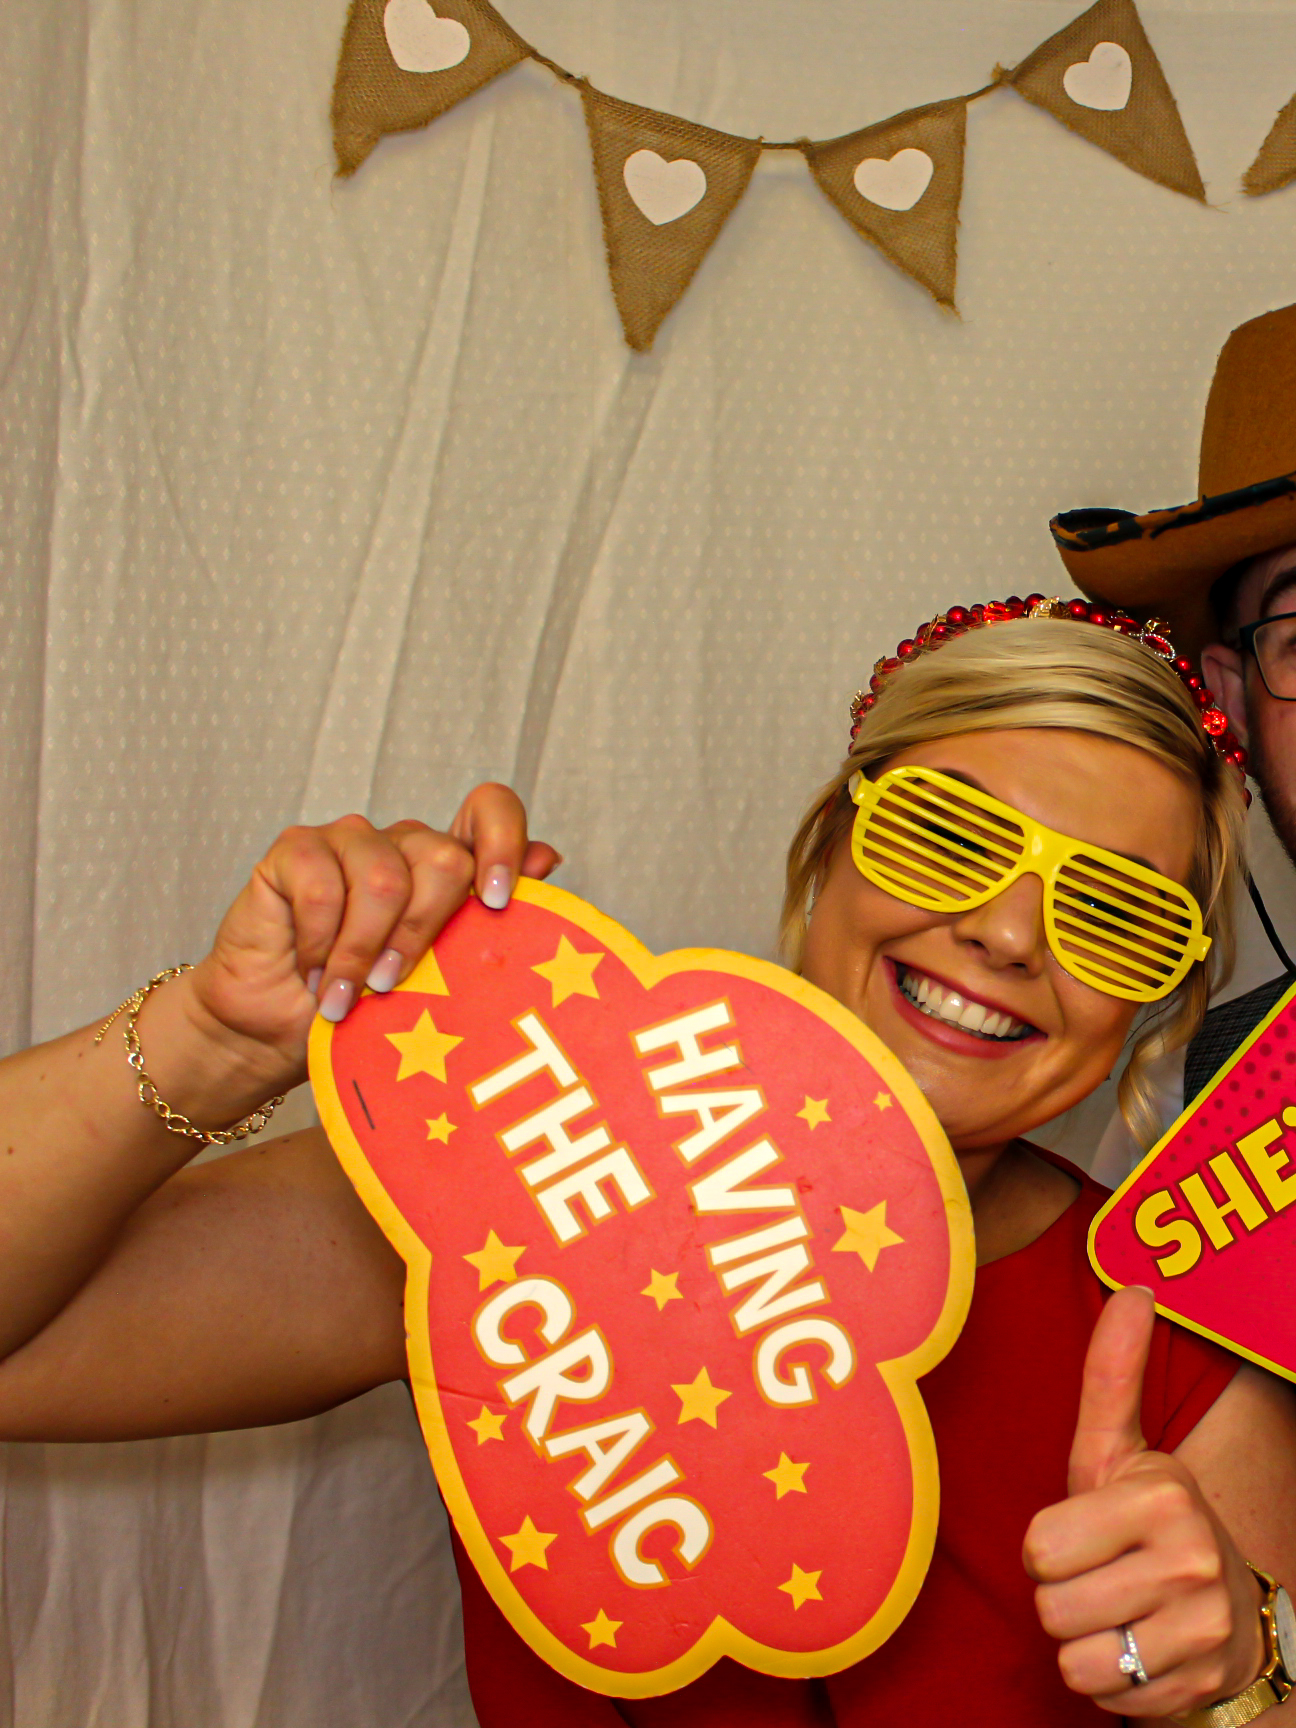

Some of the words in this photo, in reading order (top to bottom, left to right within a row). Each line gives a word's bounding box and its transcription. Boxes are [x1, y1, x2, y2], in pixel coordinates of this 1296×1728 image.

[467, 1009, 653, 1247] THE
[631, 998, 856, 1406] HAVING
[473, 1275, 713, 1589] CRAIC
